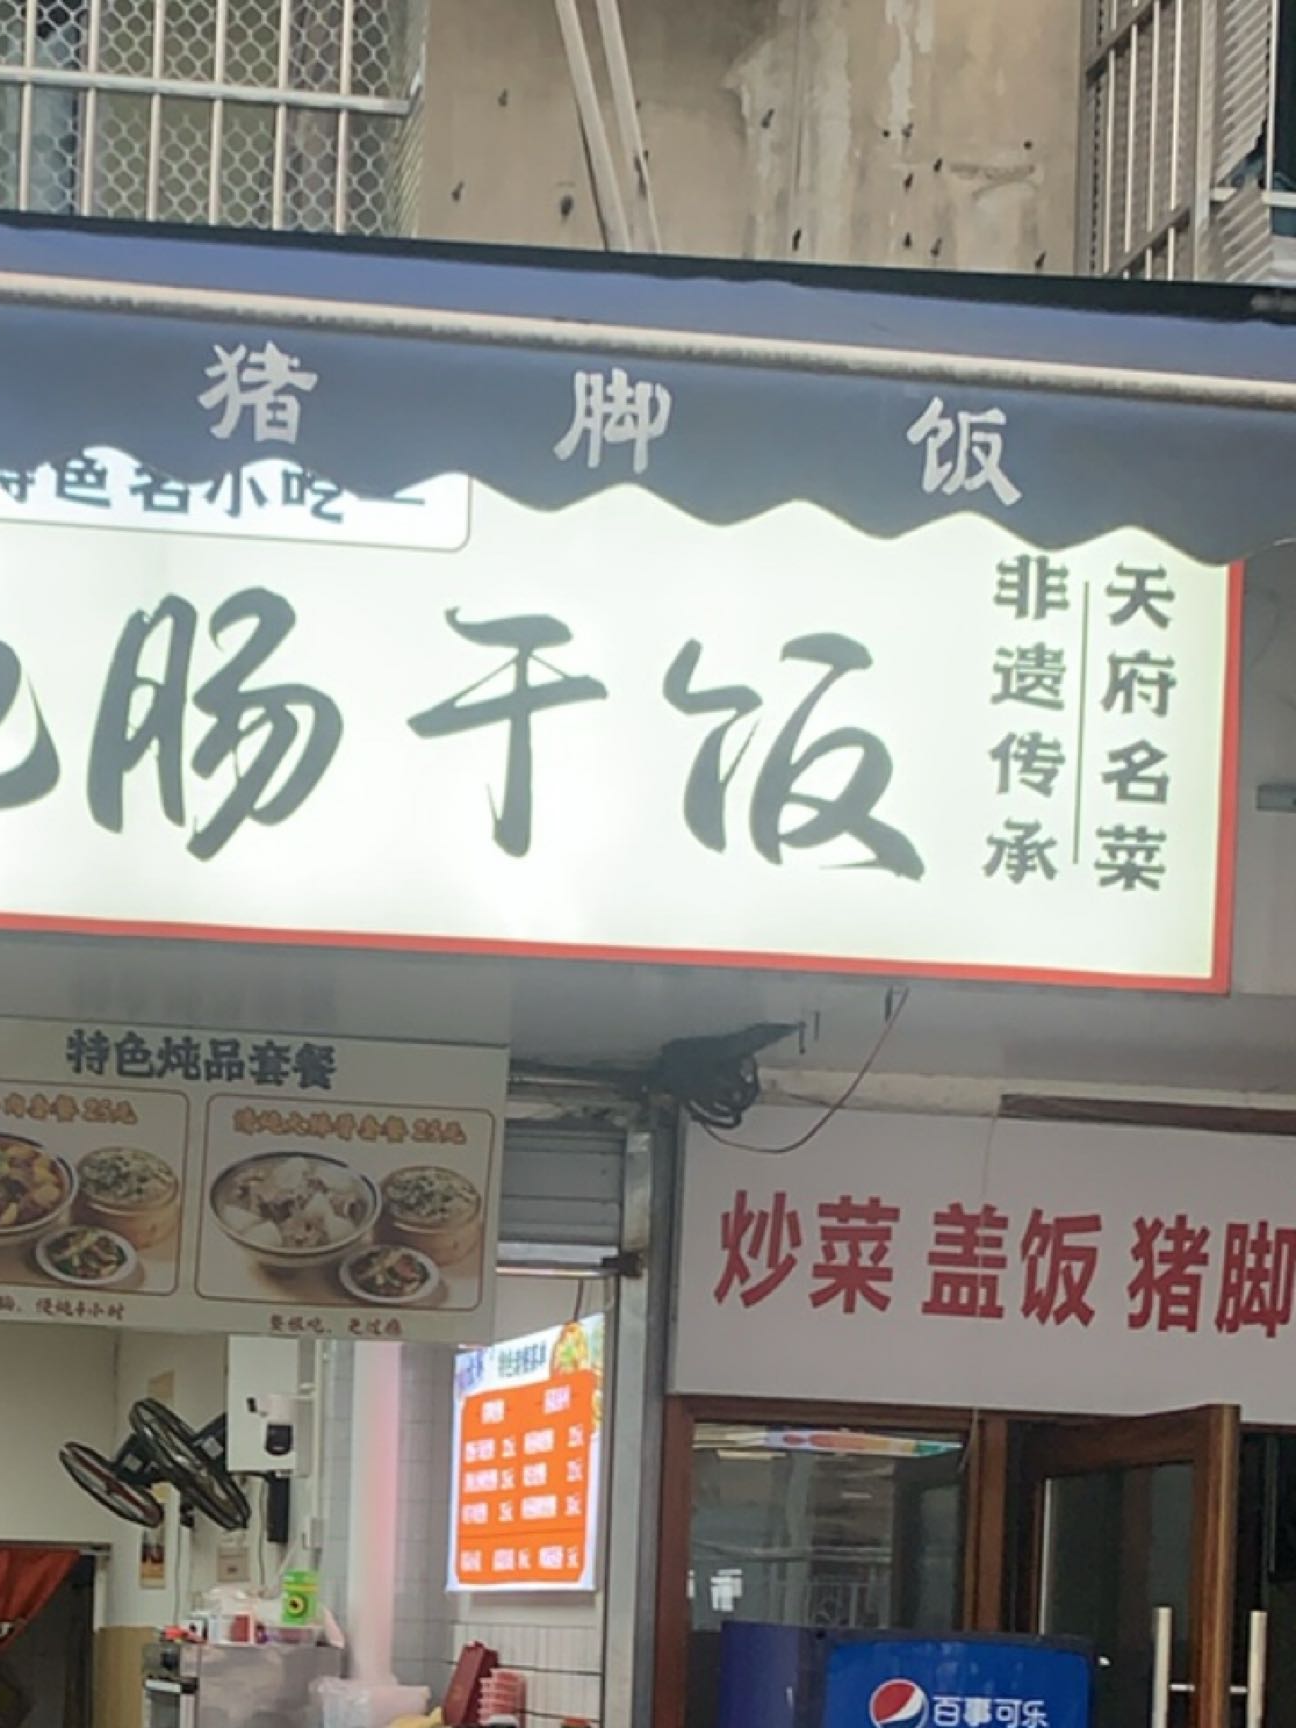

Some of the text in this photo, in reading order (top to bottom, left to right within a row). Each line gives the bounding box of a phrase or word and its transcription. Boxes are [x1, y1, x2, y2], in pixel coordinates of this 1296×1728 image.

[983, 554, 1072, 886] 非遗传承
[1093, 561, 1179, 892] 天府名菜
[65, 1028, 338, 1090] 特色炖品套餐
